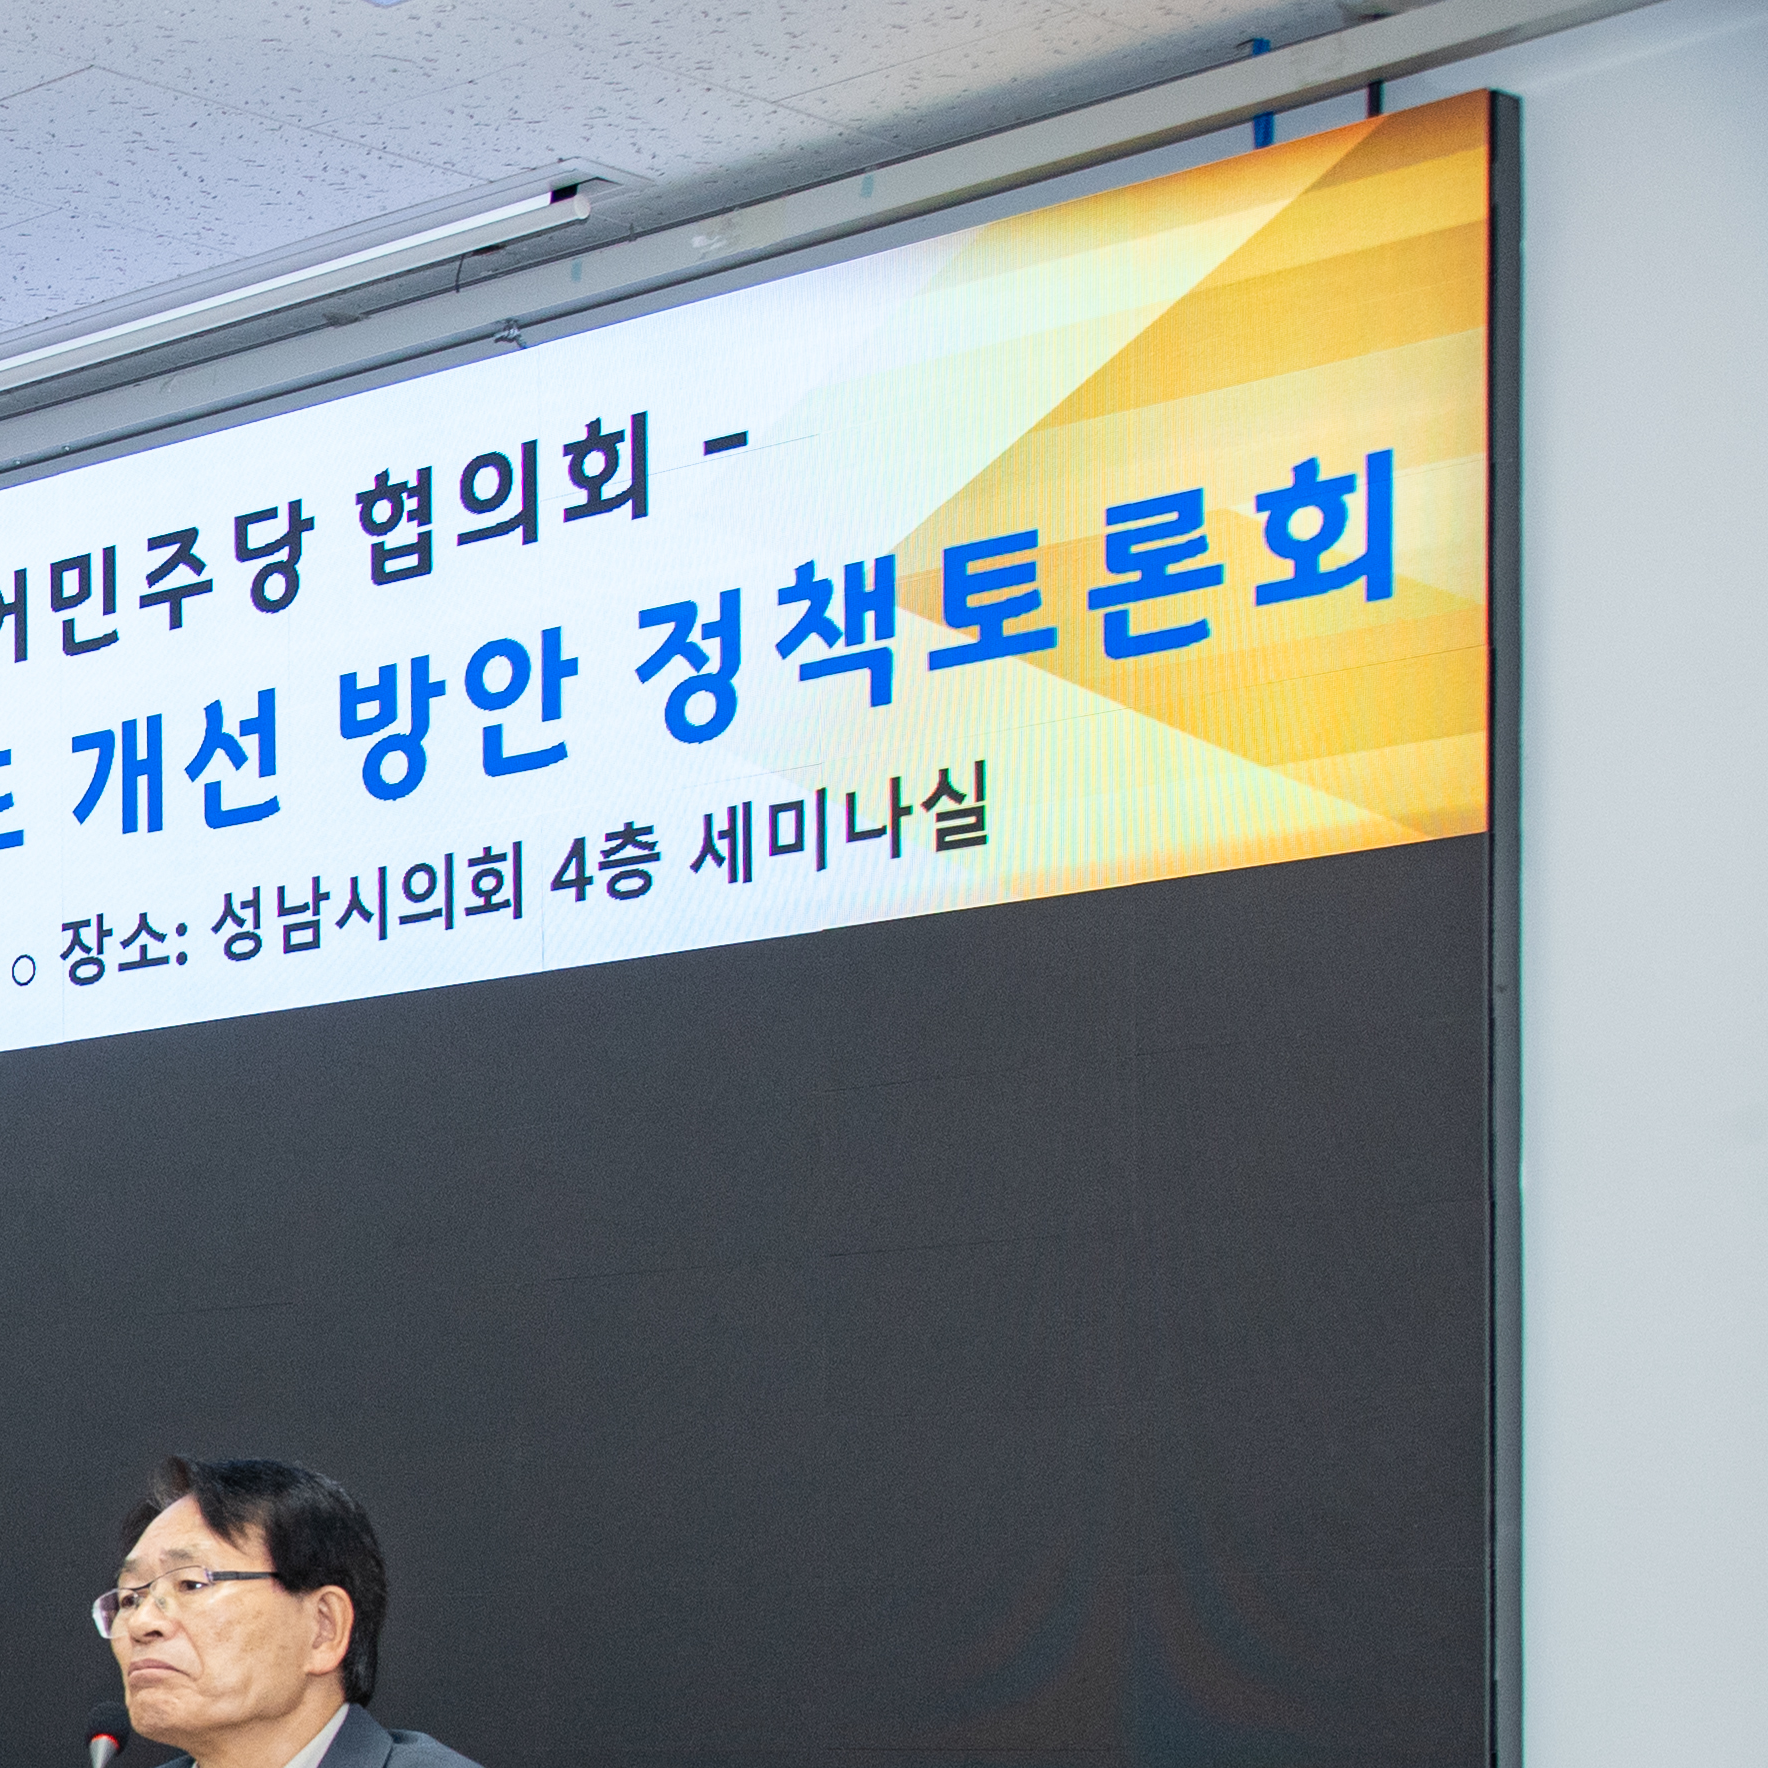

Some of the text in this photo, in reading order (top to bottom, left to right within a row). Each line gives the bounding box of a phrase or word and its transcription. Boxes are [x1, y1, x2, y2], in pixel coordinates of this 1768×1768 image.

[355, 410, 650, 587] 협의회
[71, 687, 282, 835] 개선
[339, 625, 579, 802] 방안
[634, 448, 1395, 745] 정책토론회
[59, 759, 990, 987] 장소: 성남시의회 4층 세미나실
